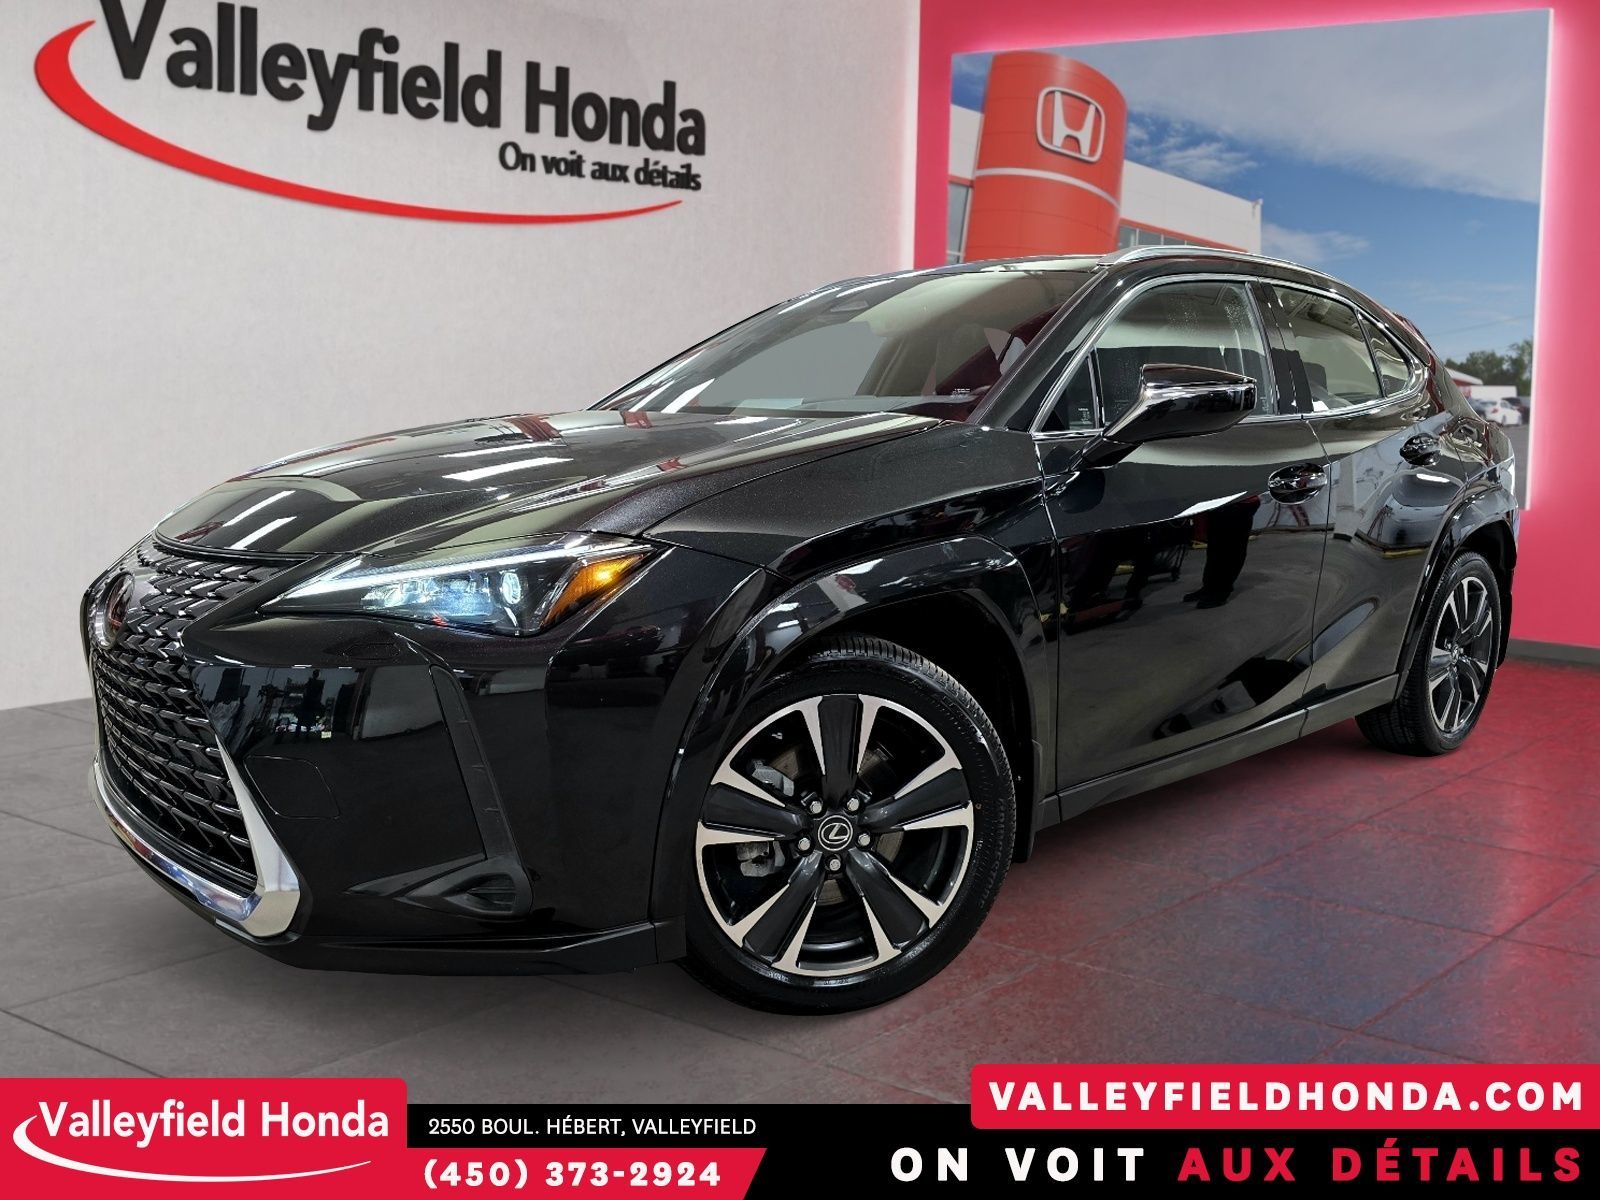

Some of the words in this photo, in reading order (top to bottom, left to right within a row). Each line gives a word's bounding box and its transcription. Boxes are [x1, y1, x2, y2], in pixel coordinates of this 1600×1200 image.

[100, 0, 502, 131] Valleyfield
[525, 61, 706, 156] Honda
[499, 141, 536, 172] On
[542, 150, 585, 178] voit
[590, 161, 630, 183] aux
[634, 158, 702, 191] détails
